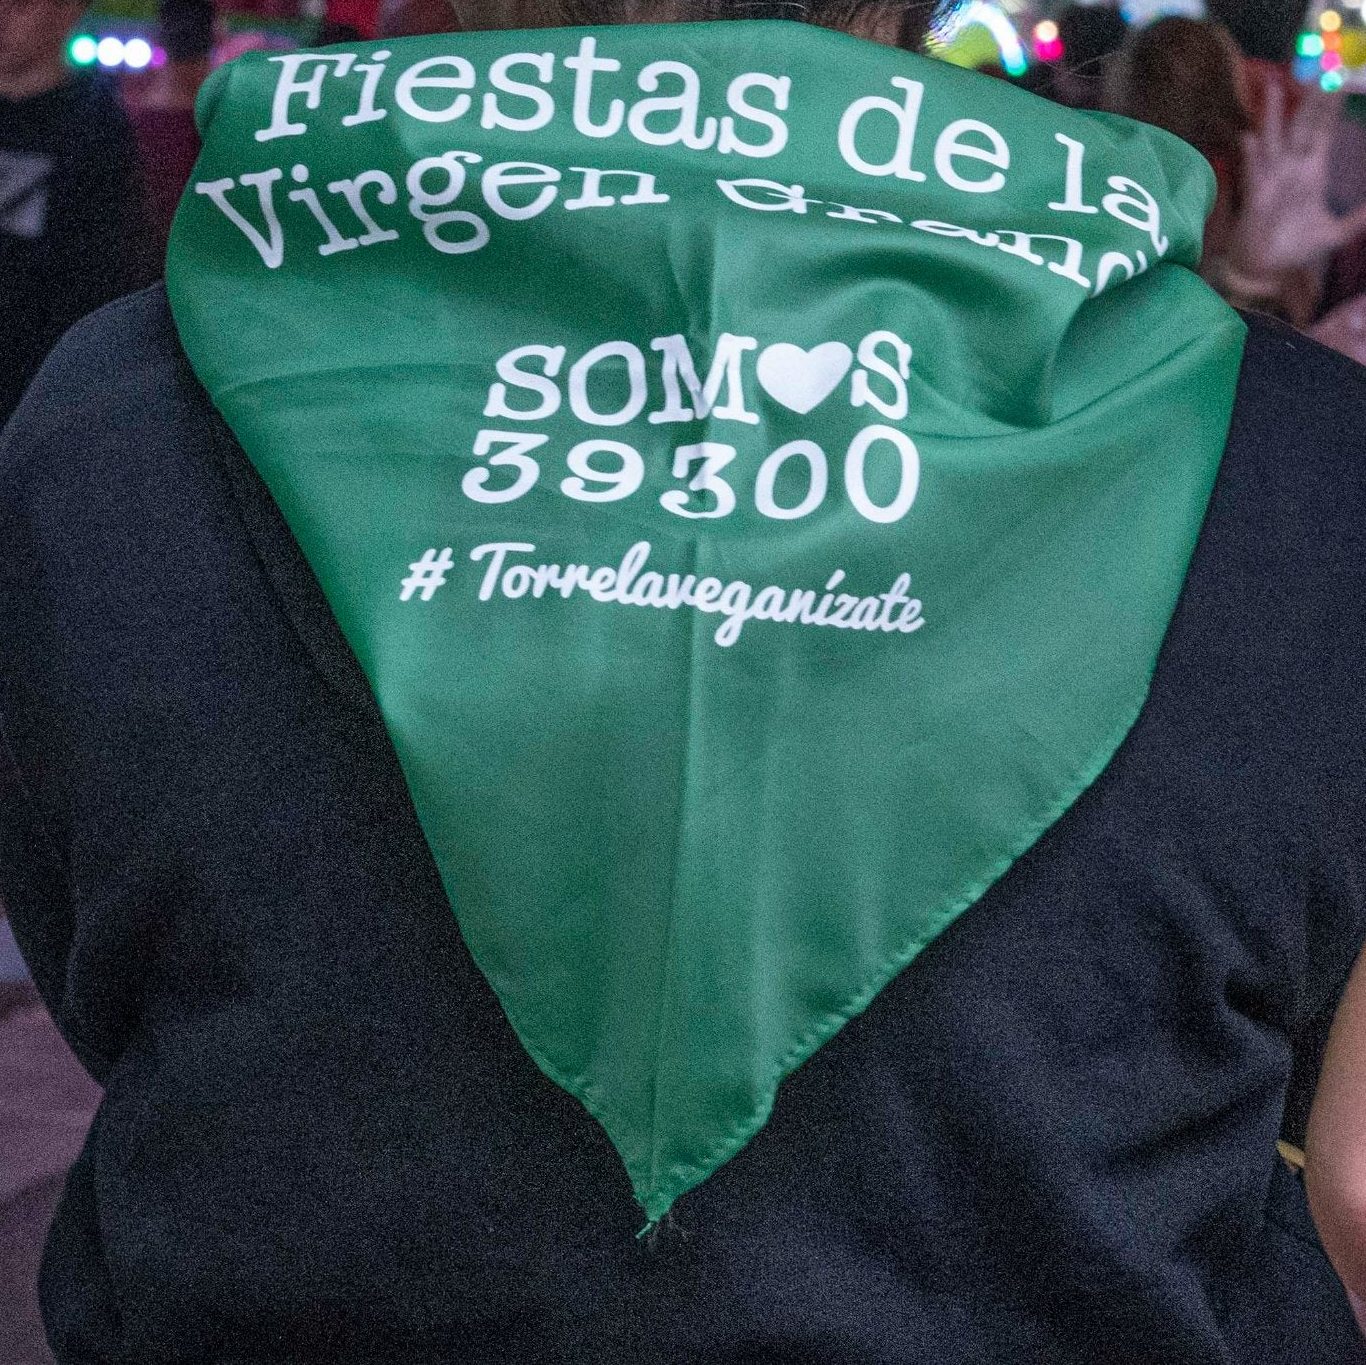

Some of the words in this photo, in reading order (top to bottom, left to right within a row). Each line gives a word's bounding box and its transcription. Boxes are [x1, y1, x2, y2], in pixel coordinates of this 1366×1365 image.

[254, 35, 792, 160] Fiestas
[837, 75, 1011, 194] de
[1047, 132, 1169, 256] la
[196, 149, 671, 269] Virgen
[460, 423, 921, 525] 39300
